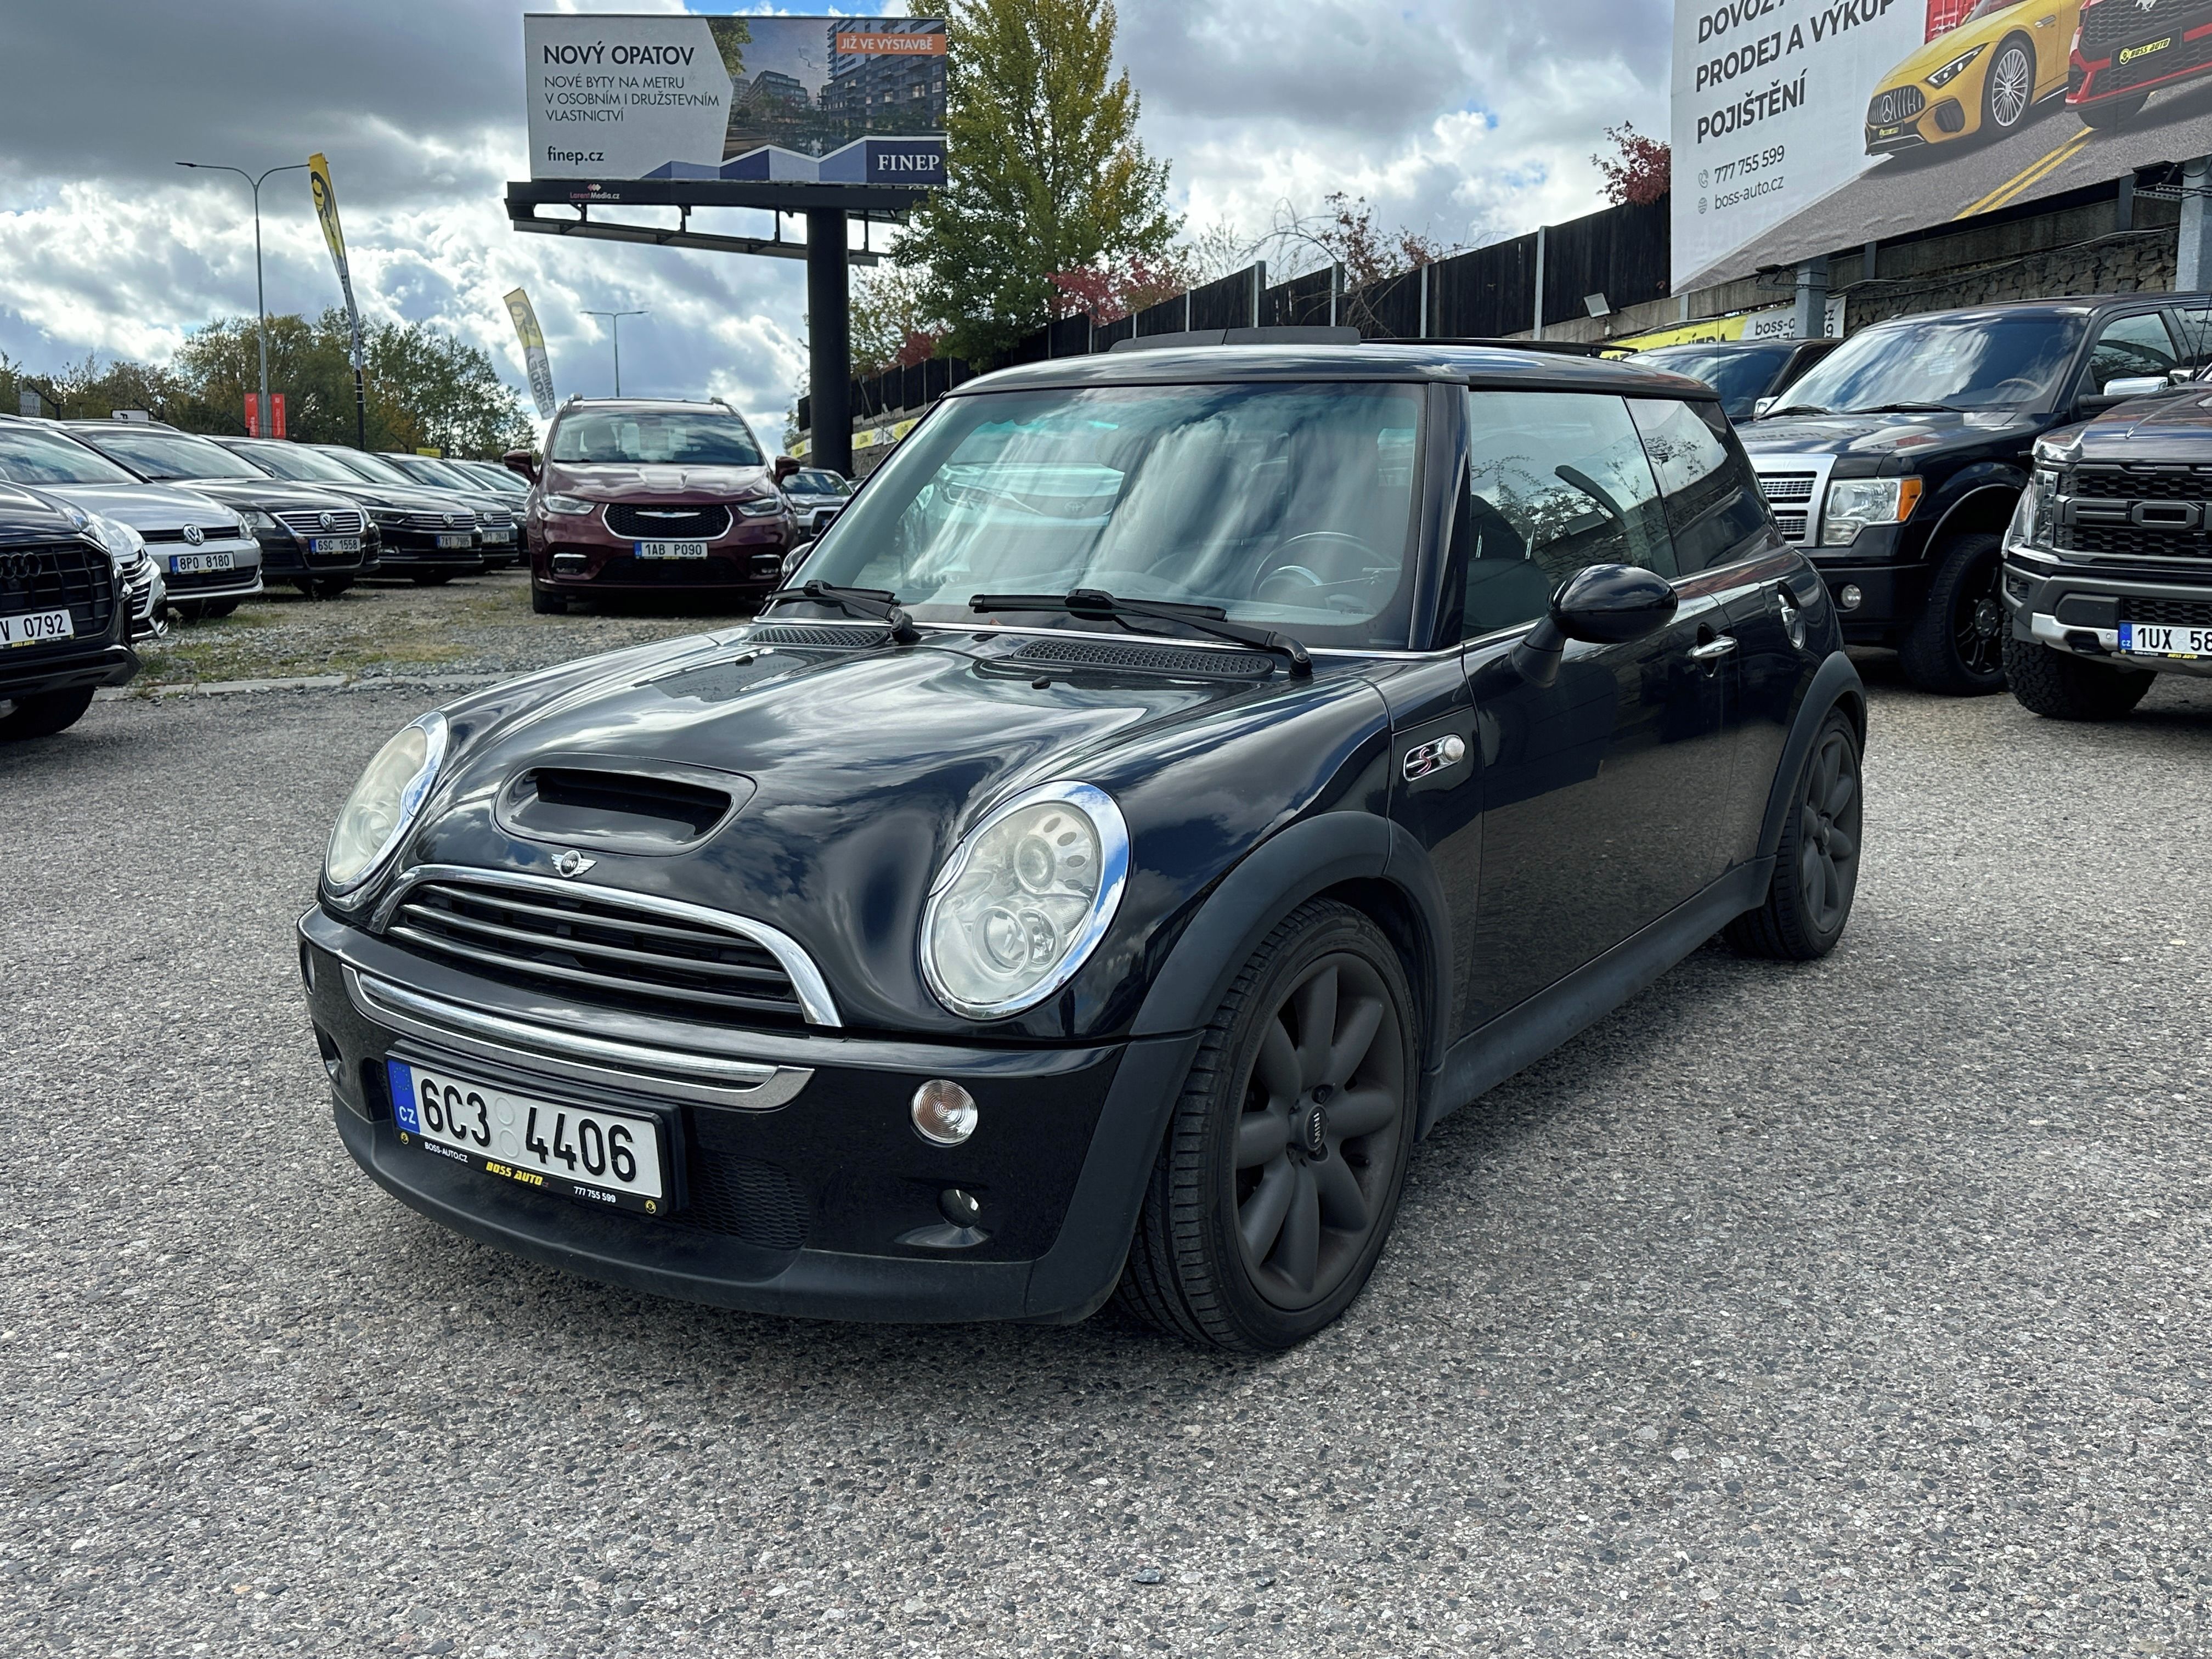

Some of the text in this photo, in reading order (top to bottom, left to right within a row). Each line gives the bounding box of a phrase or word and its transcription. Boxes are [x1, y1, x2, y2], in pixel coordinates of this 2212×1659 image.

[841, 35, 933, 50] JIŽ VE VÝSTAVBĚ
[1696, 0, 1893, 92] PRODEJ A VÝKUP
[544, 41, 695, 65] NOVÝ OPATOV
[545, 73, 684, 88] NOVÉ BYTY NA METRU
[545, 90, 719, 106] V OSOBNÍM I DRUŽSTEVNÍM
[1697, 68, 1808, 144] POJIŠTĚNÍ
[545, 107, 624, 121] VLASTNICTVÍ
[548, 146, 604, 165] finep.cz
[878, 155, 940, 171] FINEP
[1714, 145, 1785, 184] 777 755 599
[1715, 176, 1784, 210] boss-auto.cz
[318, 540, 333, 550] 6SC
[340, 540, 357, 550] 1558
[646, 544, 702, 555] 1AB P090
[180, 557, 199, 569] 8P0
[206, 555, 229, 567] 8180
[24, 614, 66, 637] 0792
[2138, 628, 2172, 650] 1UX
[399, 1079, 636, 1182] CZ 6C3 4406
[425, 1142, 468, 1163] BOSS-AUTO.CZ
[486, 1161, 512, 1177] BOSS
[514, 1171, 543, 1186] AUTO
[574, 1186, 585, 1196] 777
[587, 1189, 601, 1199] 755
[602, 1193, 616, 1203] 599
